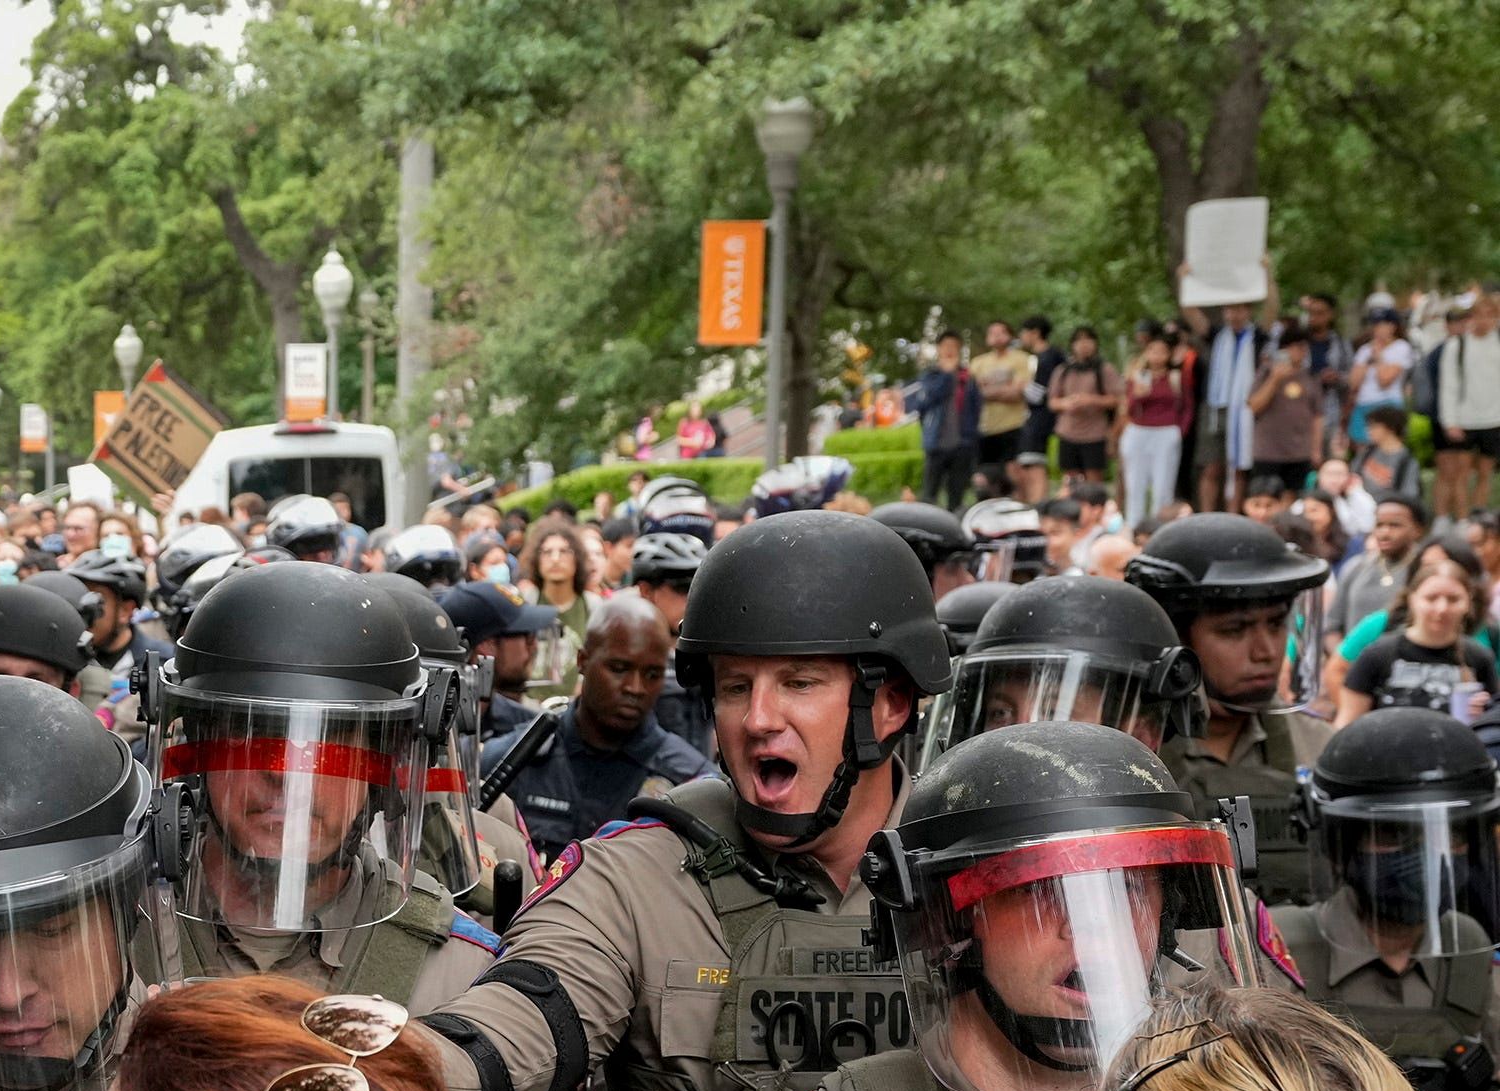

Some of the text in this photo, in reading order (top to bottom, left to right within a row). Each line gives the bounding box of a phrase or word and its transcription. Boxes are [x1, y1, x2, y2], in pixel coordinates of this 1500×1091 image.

[721, 259, 743, 331] TEXAS
[131, 392, 183, 443] FREE
[697, 967, 730, 985] FRE
[751, 989, 917, 1049] STATE PO
